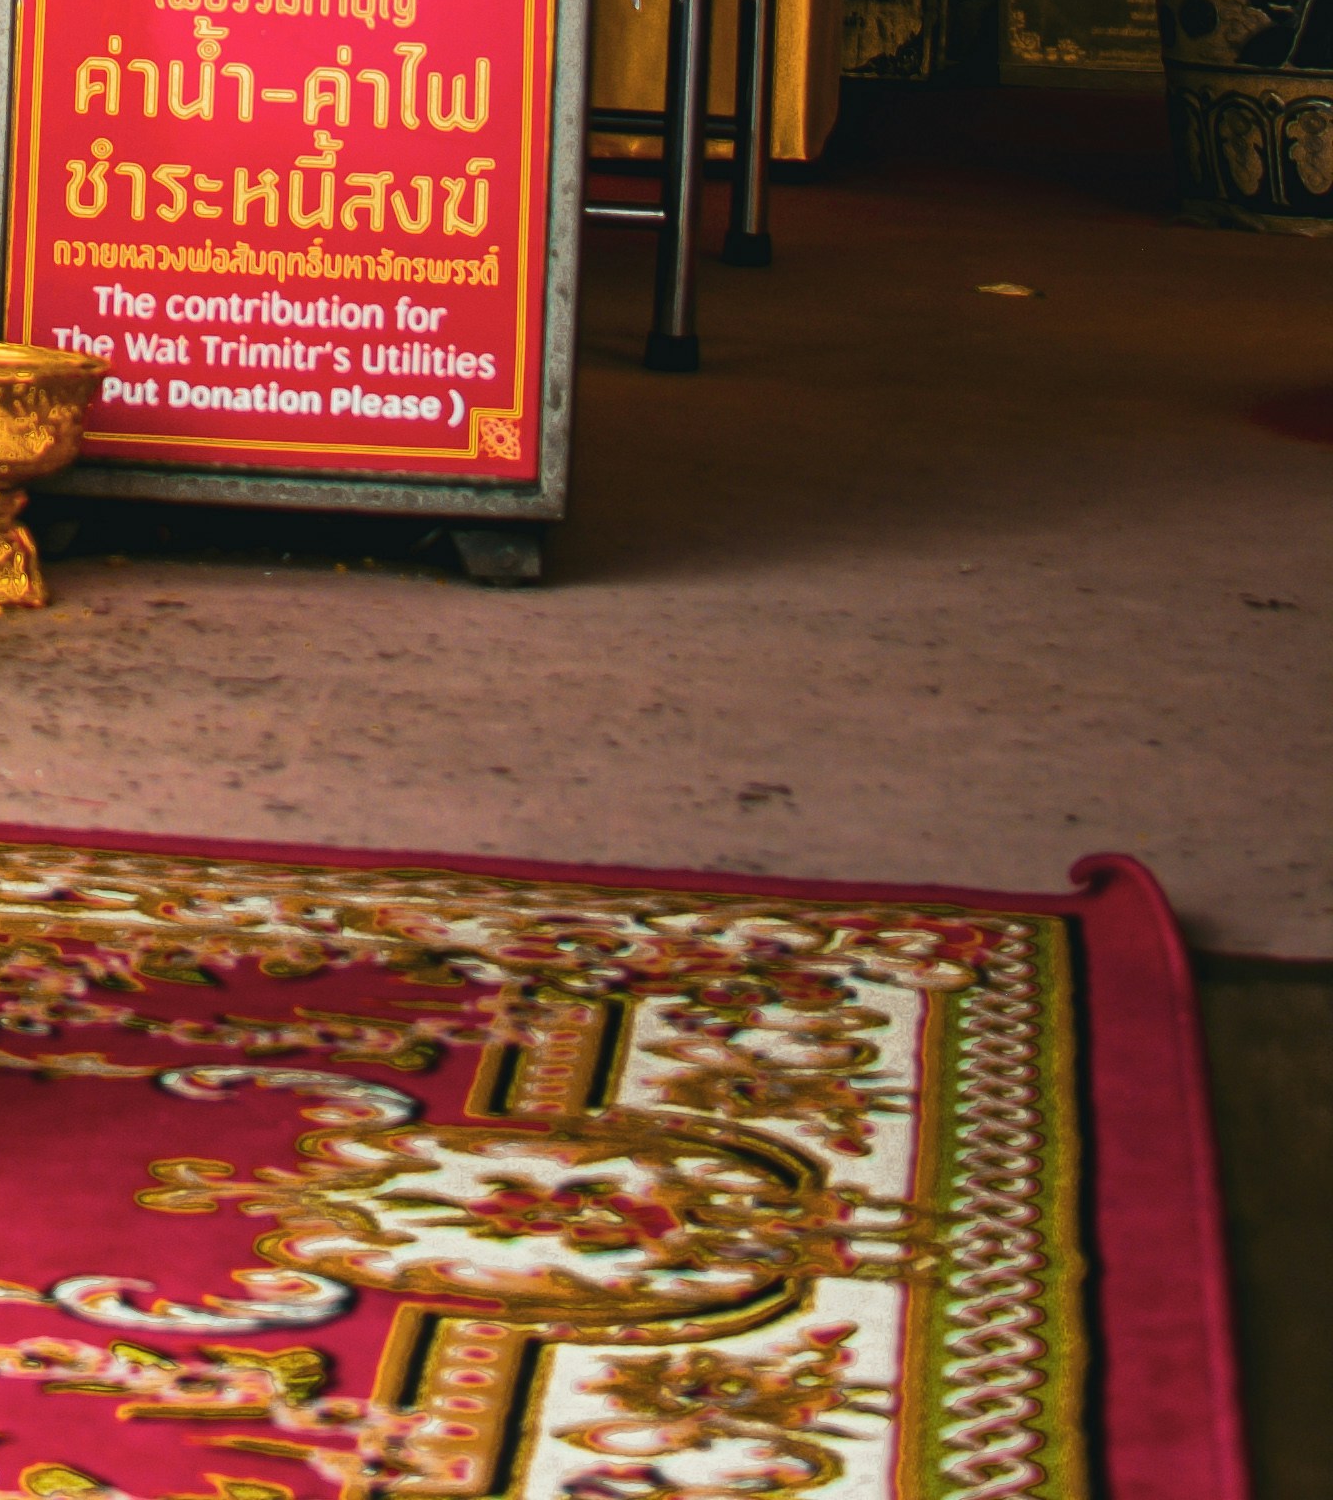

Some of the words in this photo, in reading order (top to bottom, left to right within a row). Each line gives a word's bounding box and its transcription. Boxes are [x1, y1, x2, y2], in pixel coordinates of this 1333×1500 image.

[73, 15, 491, 133] ค่าน้ำ-ค่าไฟ
[64, 128, 497, 237] ชำระหนี้สงฆ์
[92, 283, 157, 319] The
[165, 290, 385, 331] contribution
[395, 295, 448, 333] for
[124, 331, 191, 366] Wat
[361, 341, 498, 381] Utilities
[101, 375, 160, 408] Put
[168, 378, 323, 417] Donation
[329, 383, 442, 423] Please
